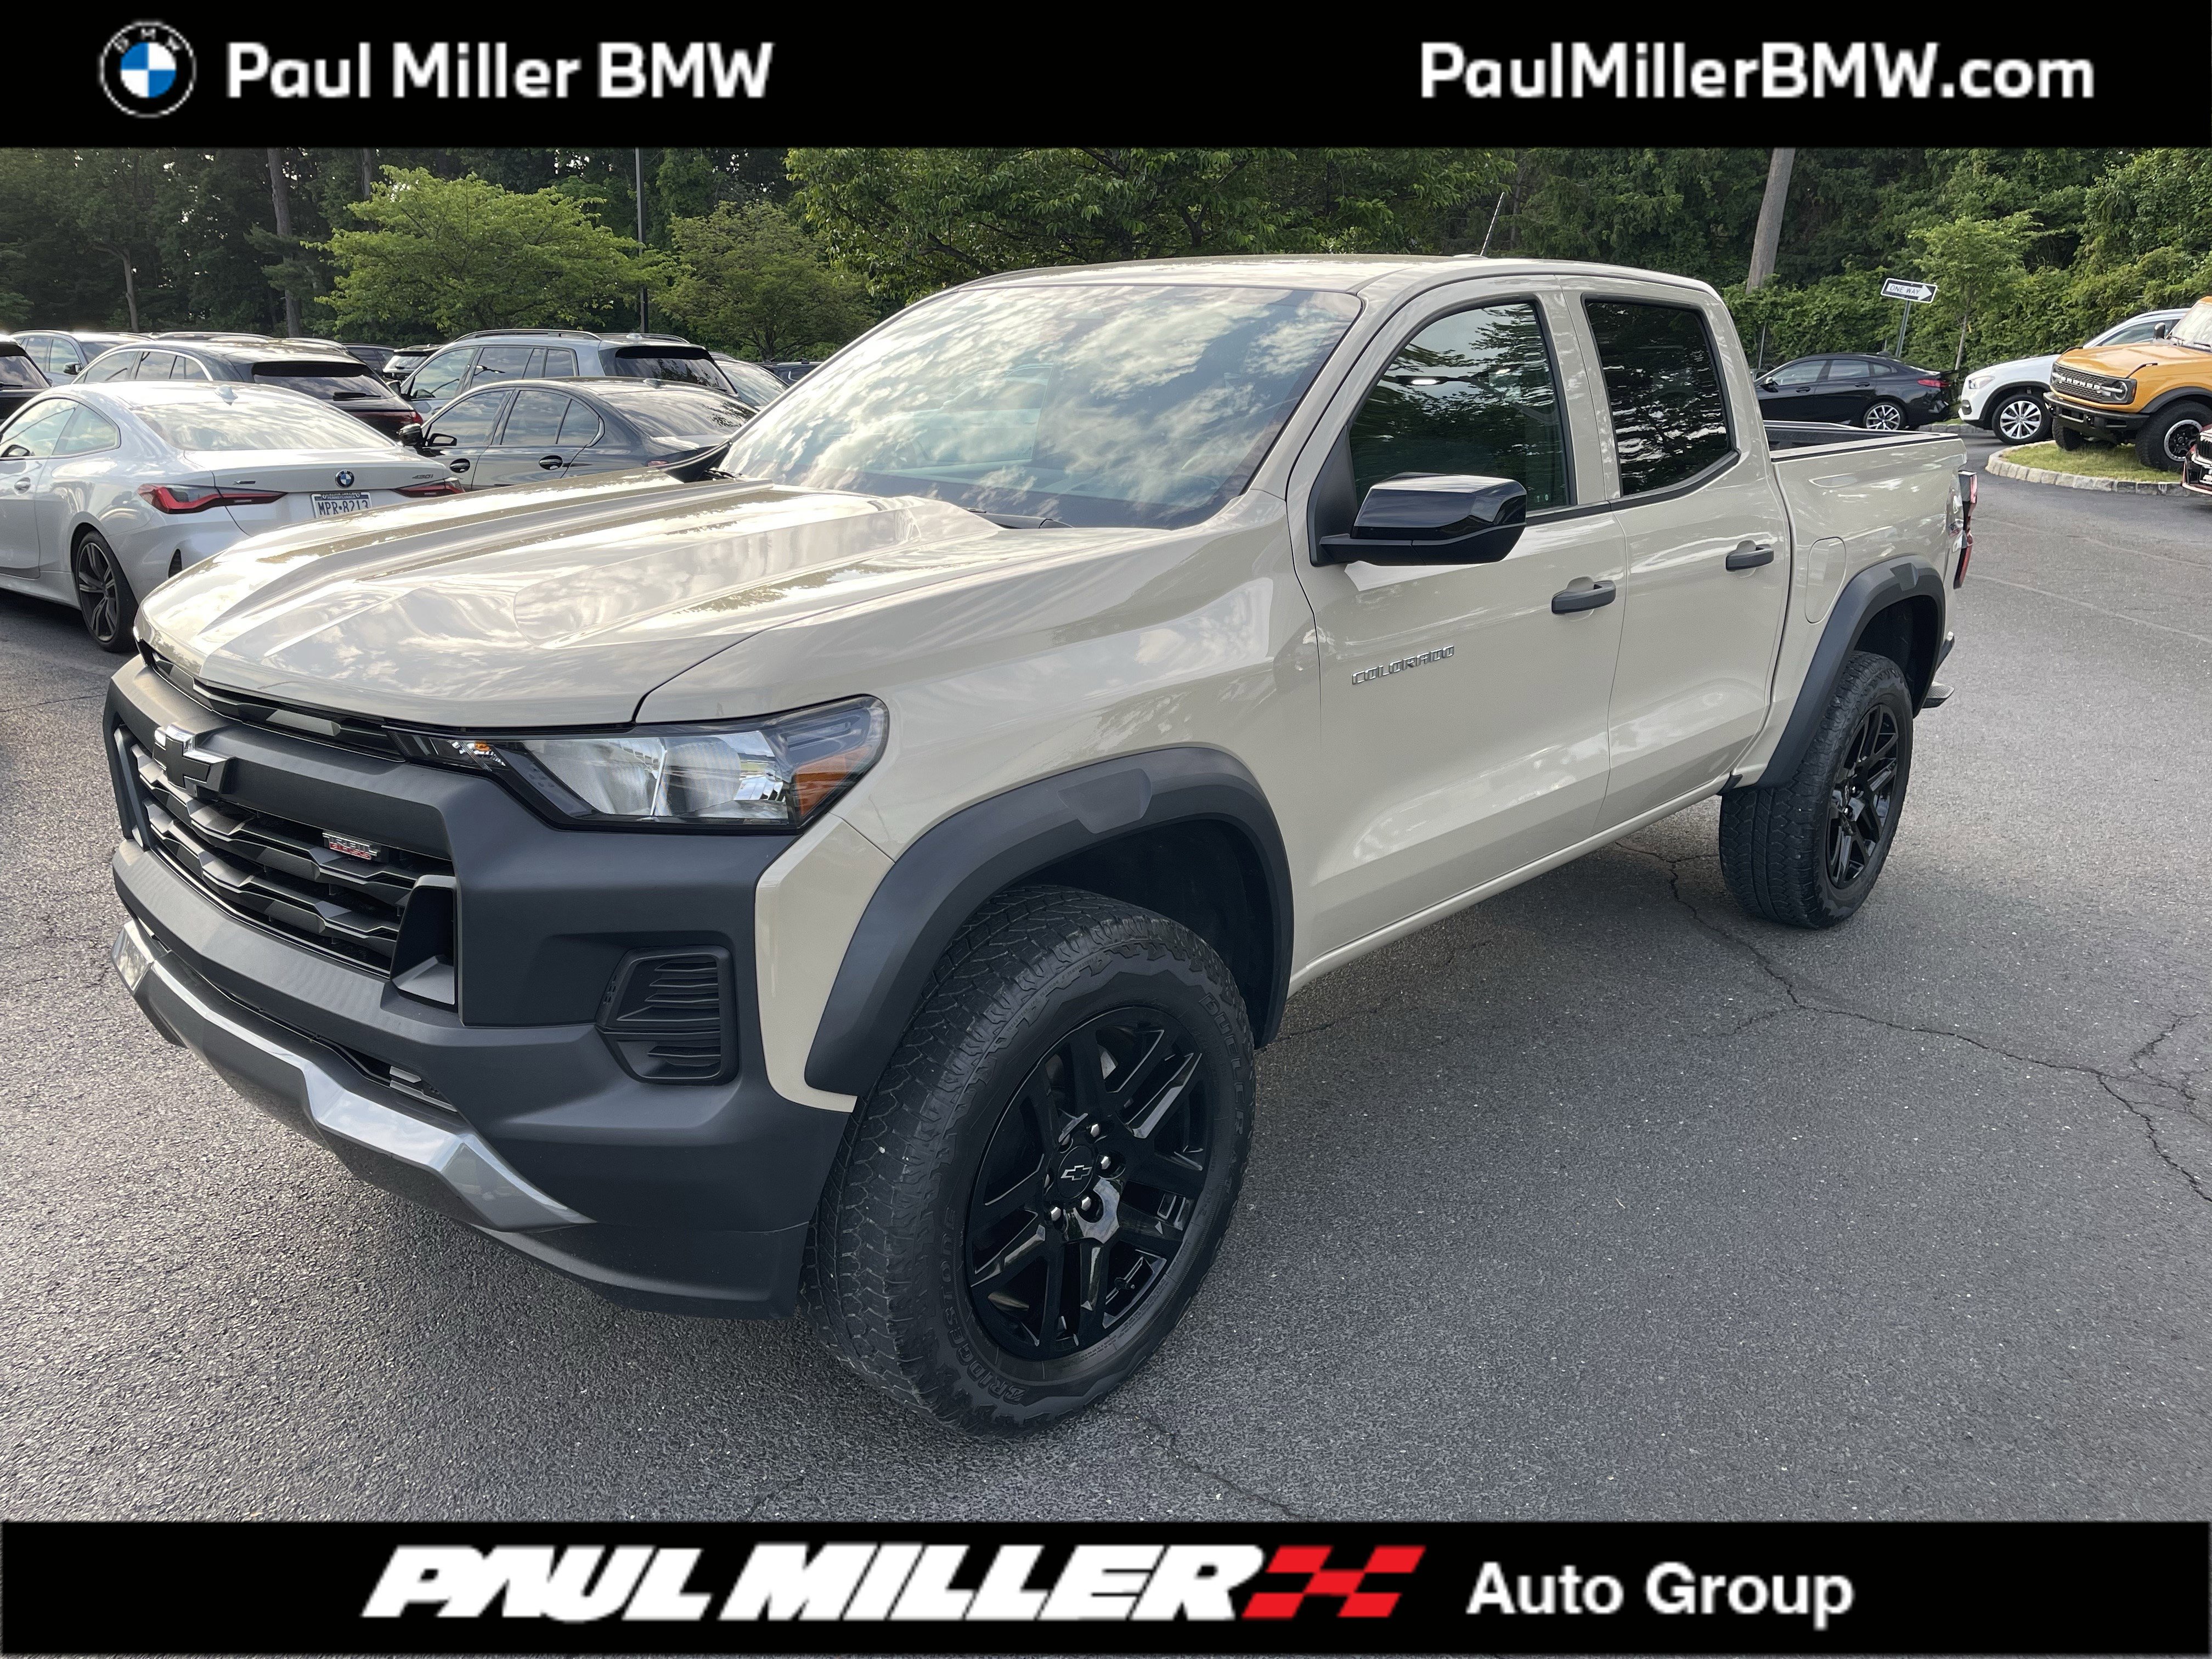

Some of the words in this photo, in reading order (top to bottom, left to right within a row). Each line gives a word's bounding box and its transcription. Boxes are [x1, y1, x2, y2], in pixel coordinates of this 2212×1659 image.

[1889, 285, 1903, 293] ONE
[2061, 376, 2101, 390] BRONCO
[1351, 645, 1455, 685] COLORADO
[329, 842, 372, 861] BOSS
[1198, 992, 1245, 1135] DUELER
[940, 1207, 1026, 1404] BRIDGESTONE
